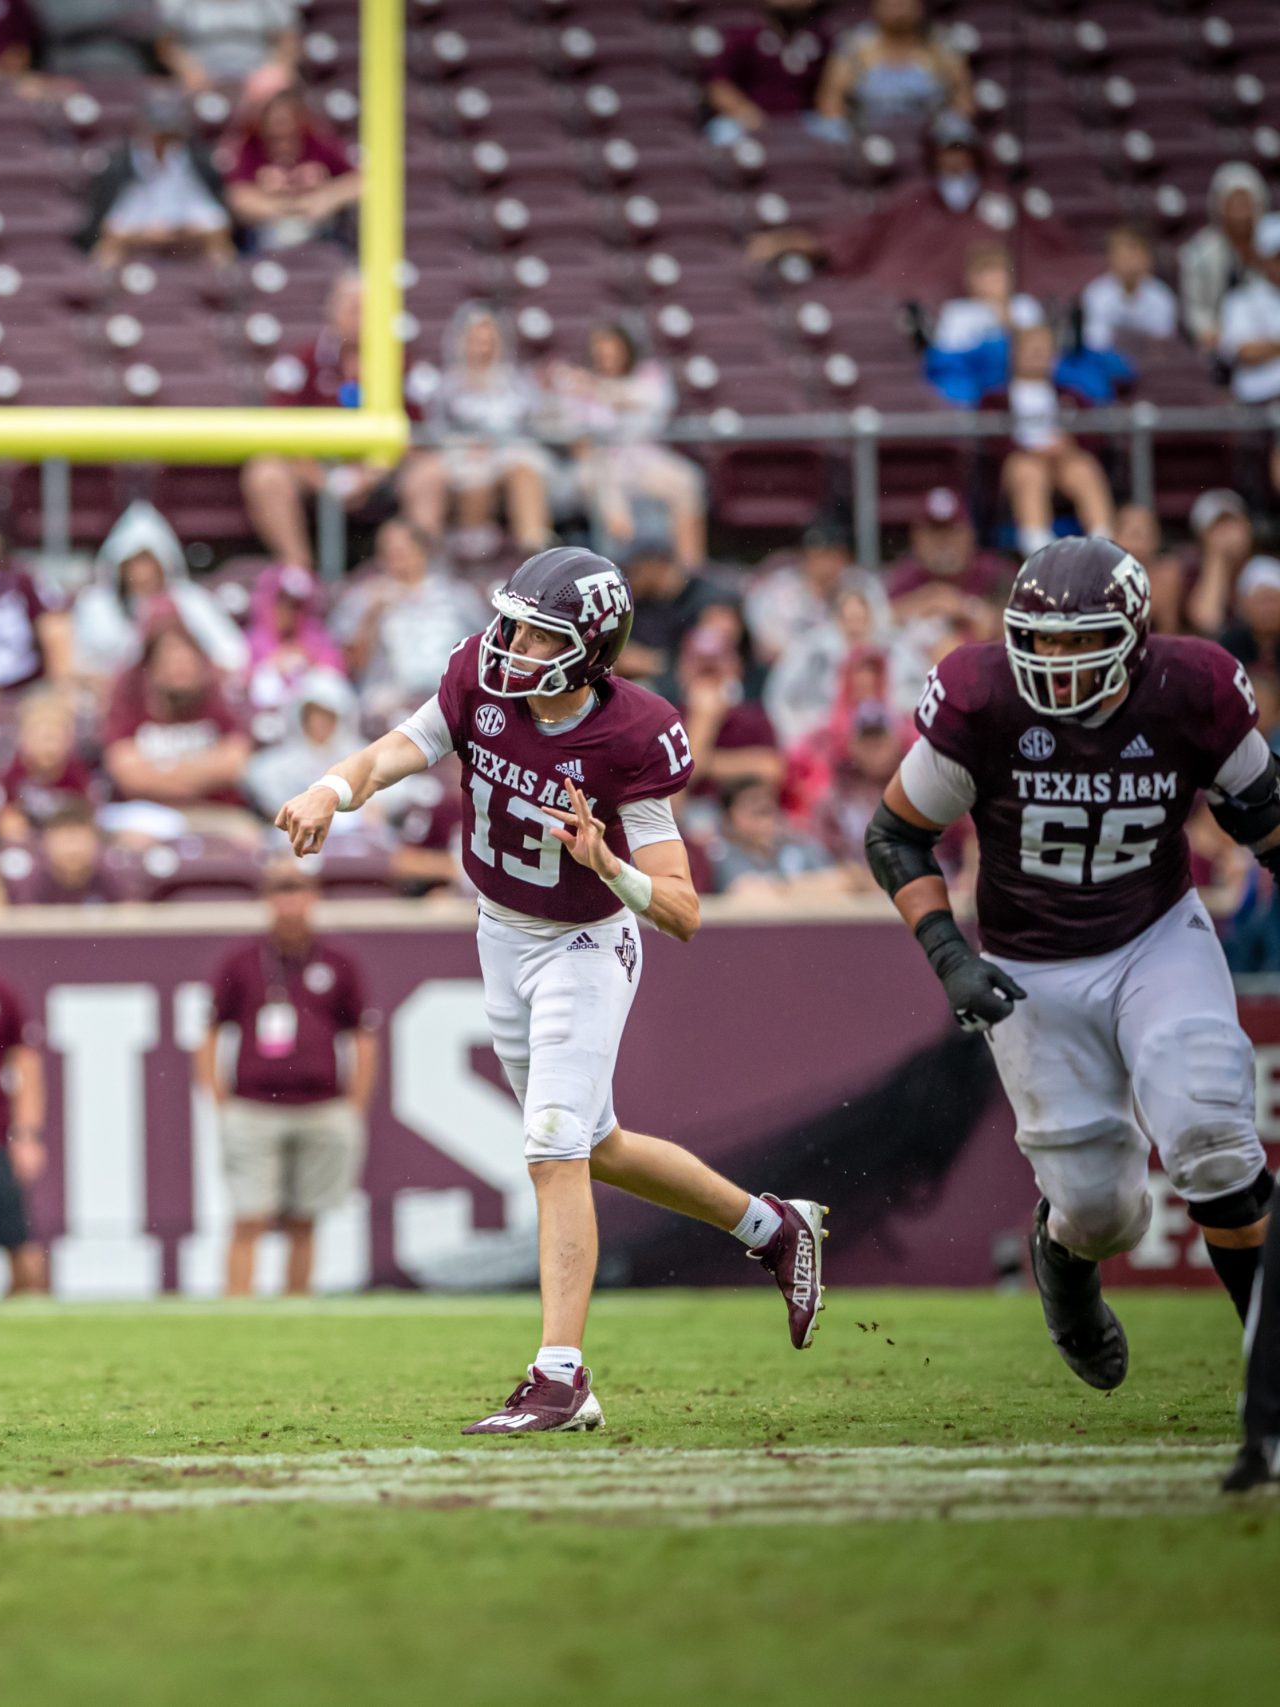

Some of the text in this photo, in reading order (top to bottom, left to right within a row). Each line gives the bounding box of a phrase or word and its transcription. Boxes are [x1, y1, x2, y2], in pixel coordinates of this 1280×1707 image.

[477, 705, 505, 735] SEC
[657, 721, 692, 776] 13
[1021, 730, 1053, 758] SEC
[467, 741, 539, 796] TEXAS
[555, 764, 585, 783] adidas
[1012, 769, 1178, 803] TEXAS A&M
[469, 772, 565, 888] 13
[1019, 803, 1166, 885] 66
[566, 942, 600, 951] adidas
